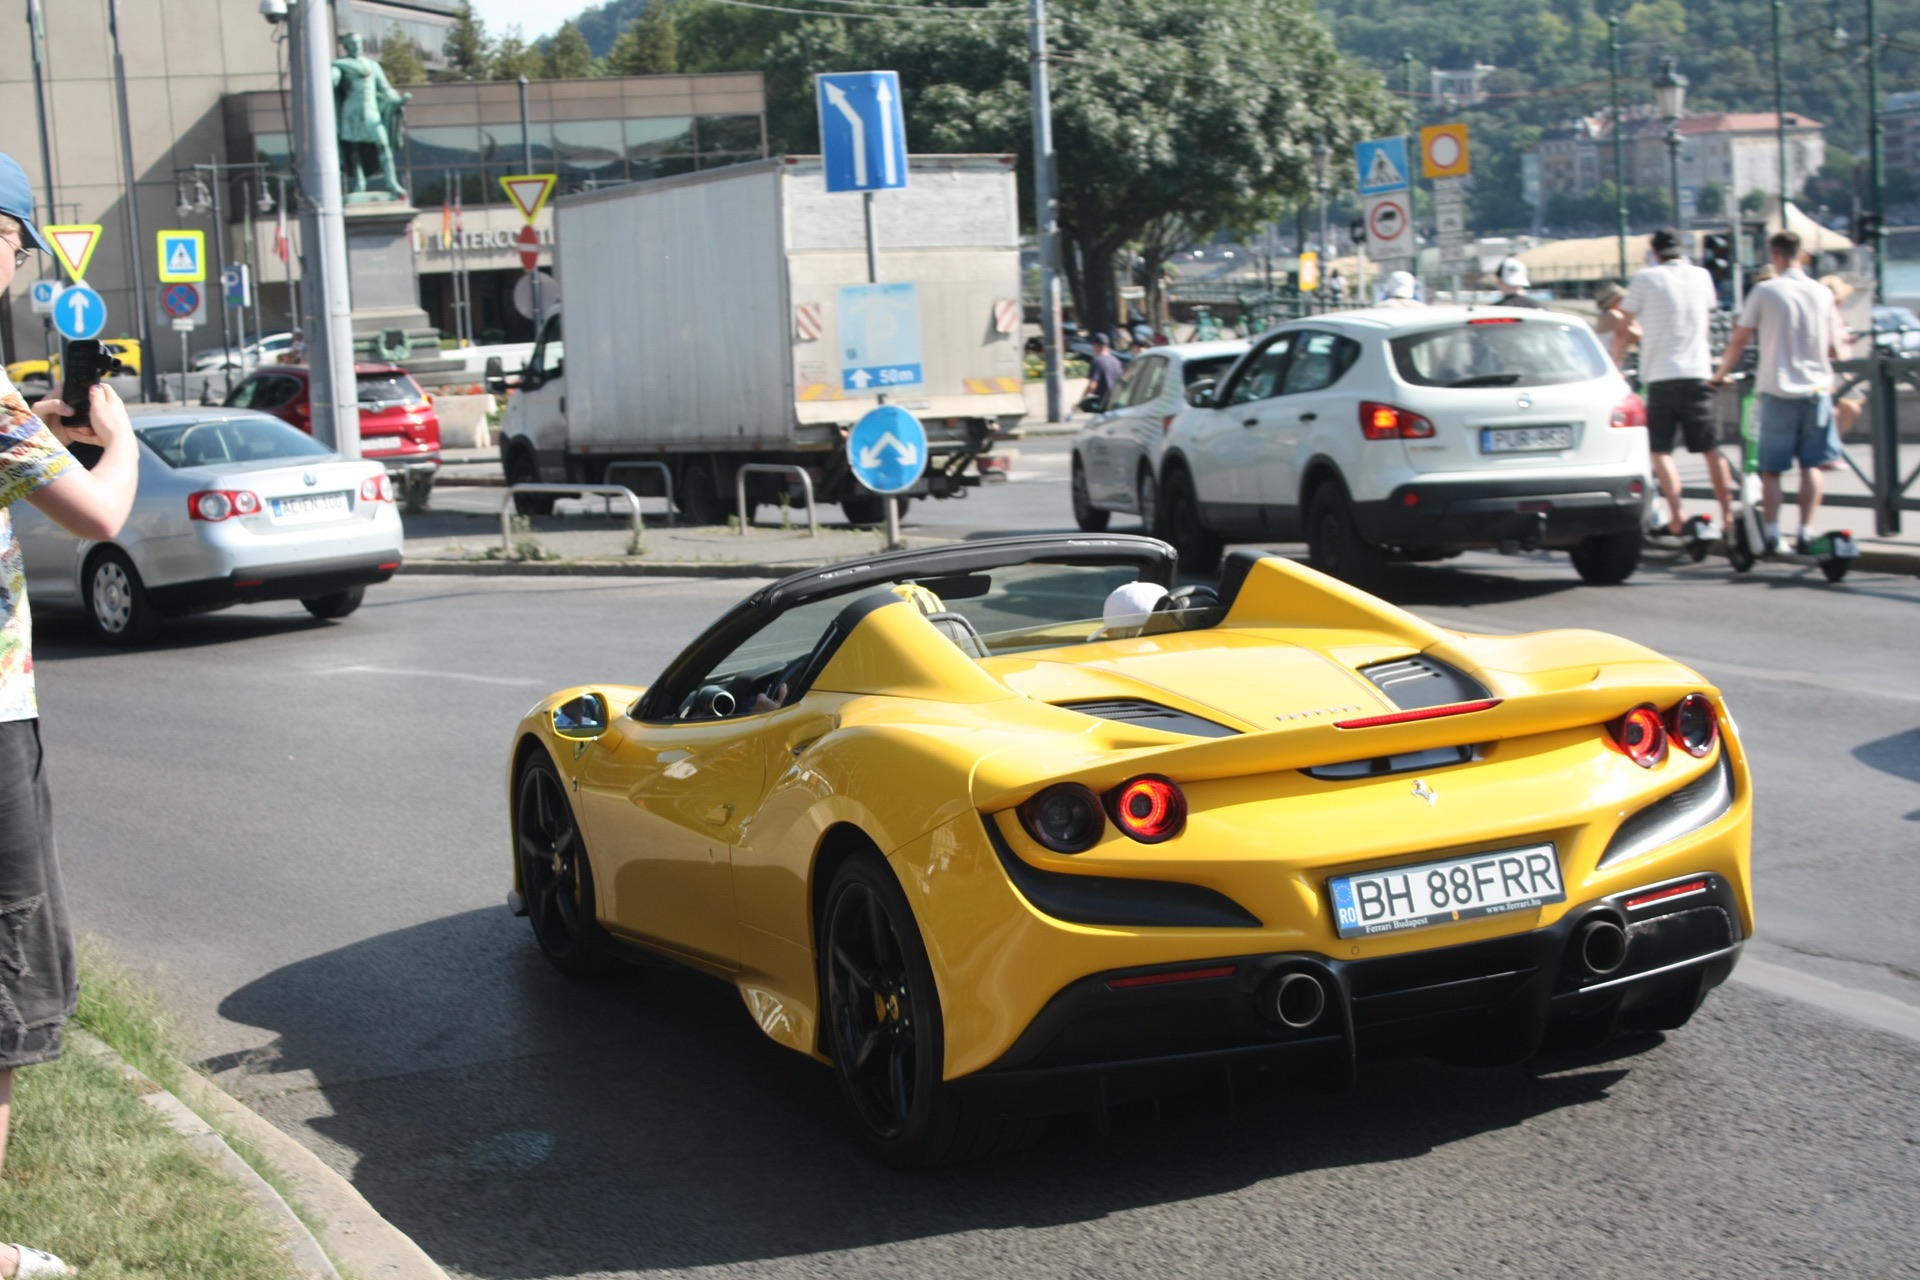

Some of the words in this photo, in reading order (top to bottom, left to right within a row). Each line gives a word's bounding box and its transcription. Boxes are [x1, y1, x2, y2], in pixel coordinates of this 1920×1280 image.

[879, 368, 914, 384] 50m
[1355, 874, 1416, 921] BH
[1427, 853, 1556, 908] 88FRR
[1485, 899, 1542, 914] www.ferrari.hu
[1340, 907, 1356, 925] RO
[1365, 921, 1392, 933] Ferrari
[1393, 916, 1428, 930] Budapest
